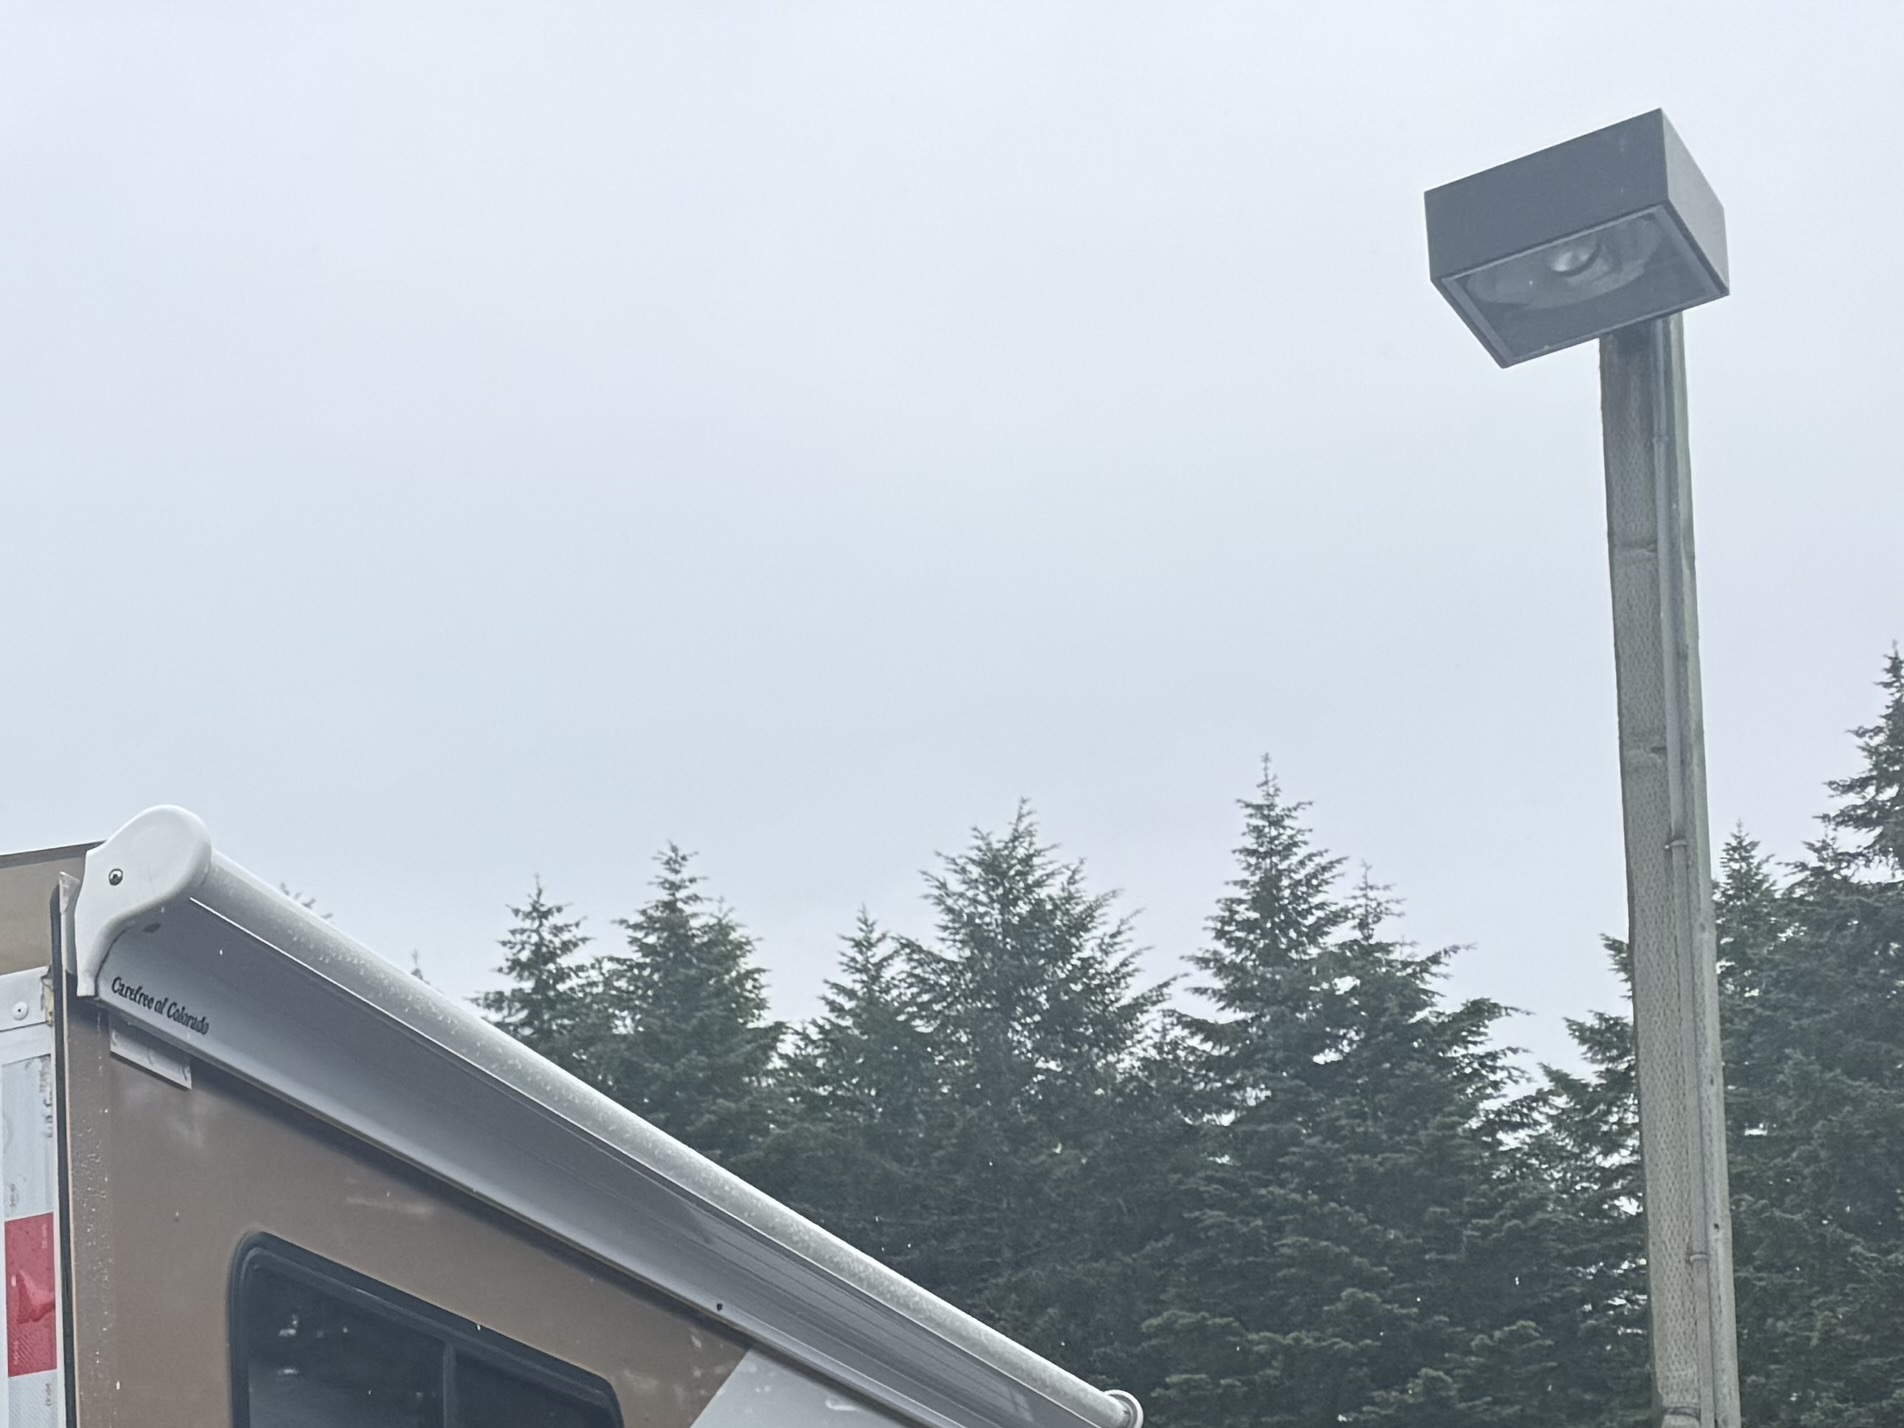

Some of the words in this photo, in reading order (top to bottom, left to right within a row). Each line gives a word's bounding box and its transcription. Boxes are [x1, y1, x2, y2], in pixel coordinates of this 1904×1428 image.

[111, 975, 154, 1011] Carefree
[154, 997, 169, 1015] of
[167, 1001, 210, 1036] Colorado
